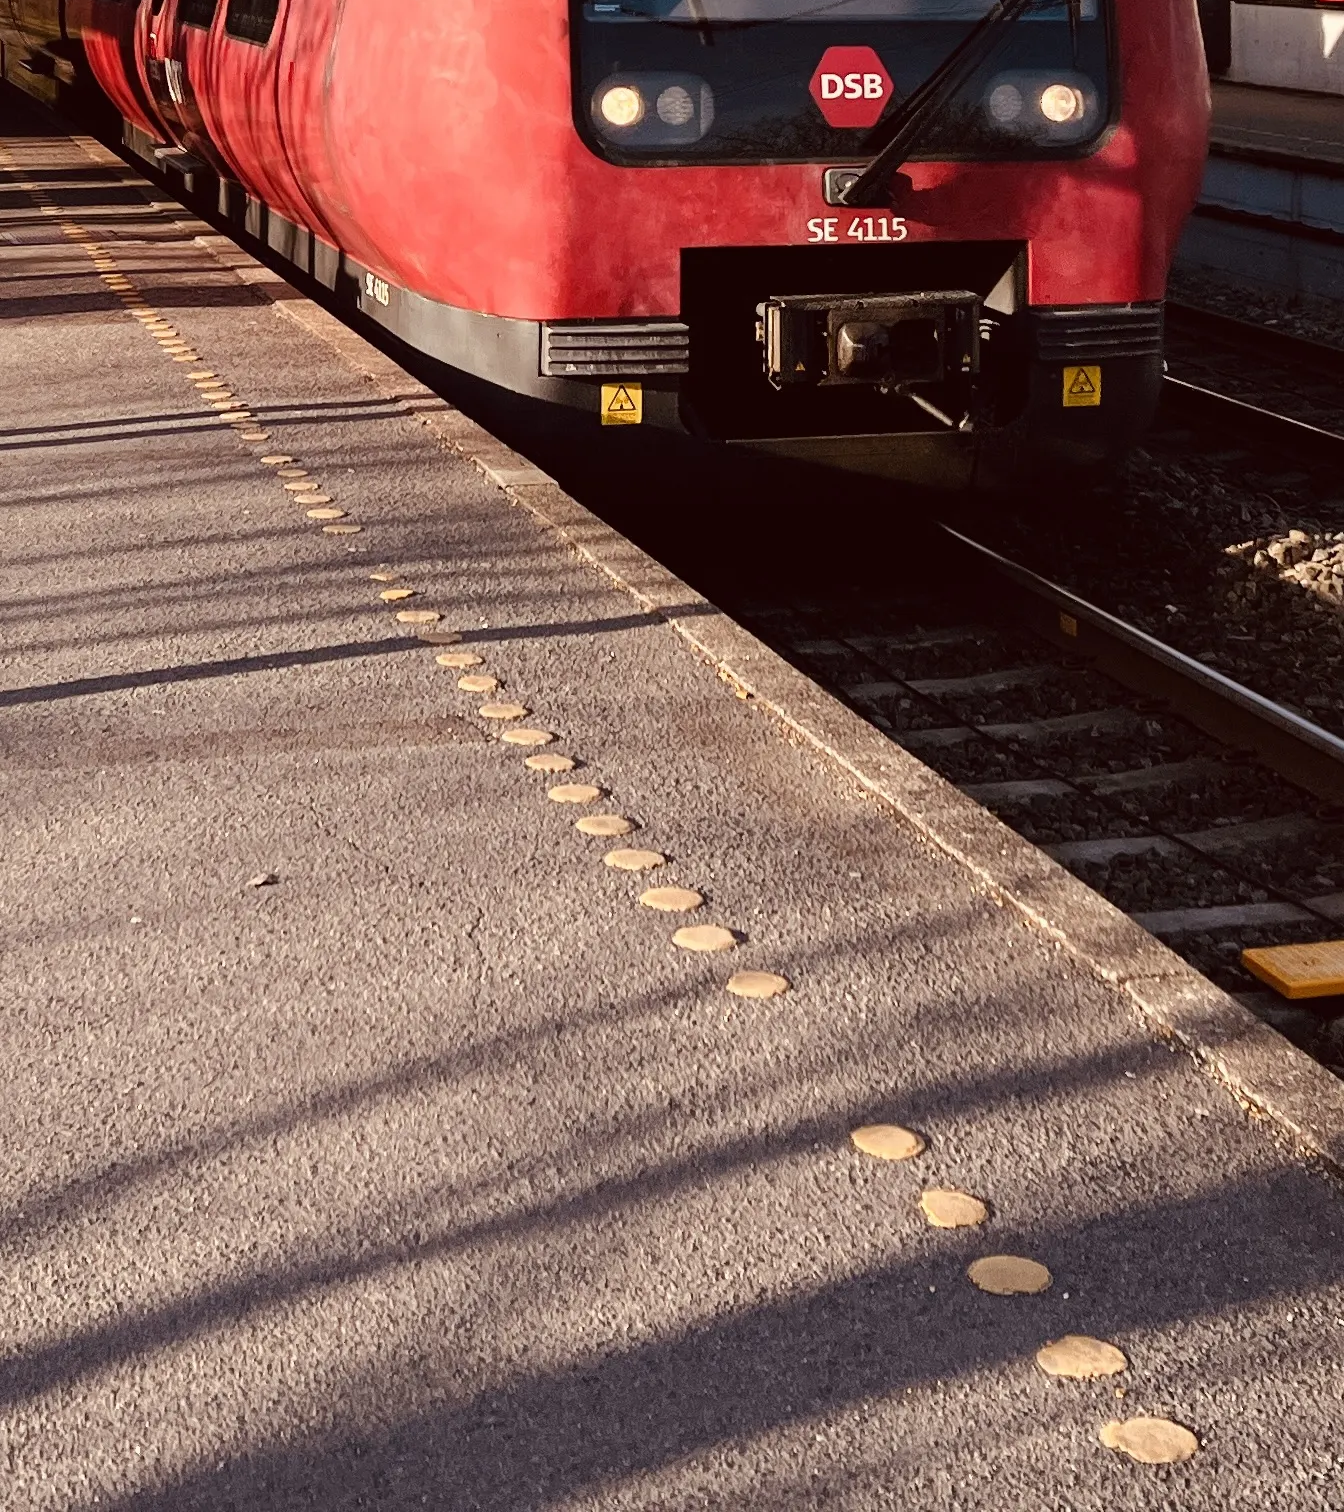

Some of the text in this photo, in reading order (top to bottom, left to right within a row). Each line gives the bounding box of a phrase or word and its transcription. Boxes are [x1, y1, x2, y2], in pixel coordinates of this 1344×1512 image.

[820, 73, 884, 100] DSB
[807, 216, 907, 243] SE 4115
